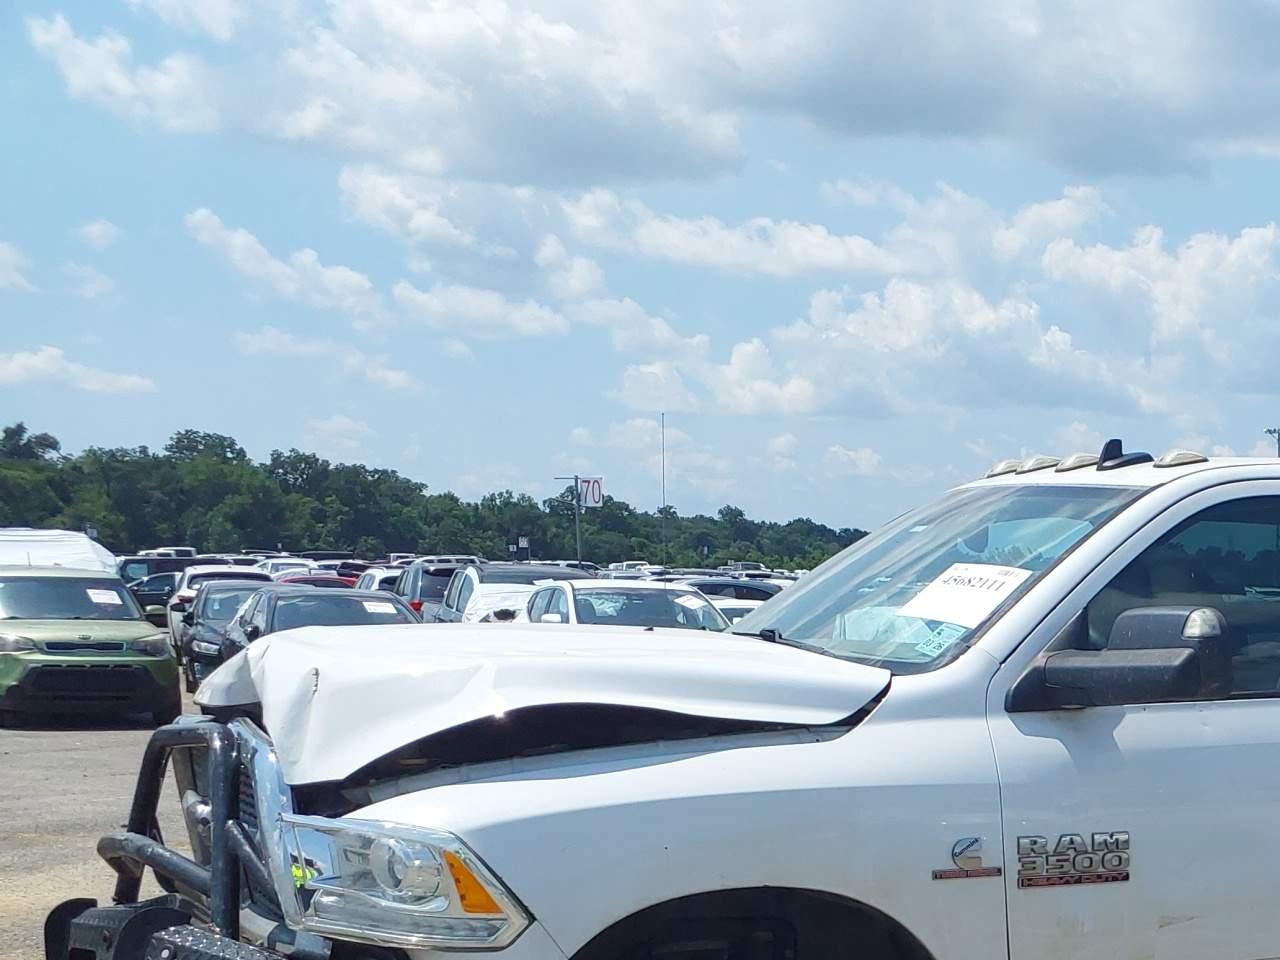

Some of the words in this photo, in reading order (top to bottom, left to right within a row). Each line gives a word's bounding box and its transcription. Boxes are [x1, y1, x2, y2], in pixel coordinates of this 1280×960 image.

[582, 479, 601, 504] 70
[942, 575, 1006, 591] 45682111
[1017, 830, 1130, 856] RAM
[1017, 850, 1130, 877] 3500
[1022, 875, 1080, 888] HEAVY
[1080, 871, 1127, 883] DUTY
